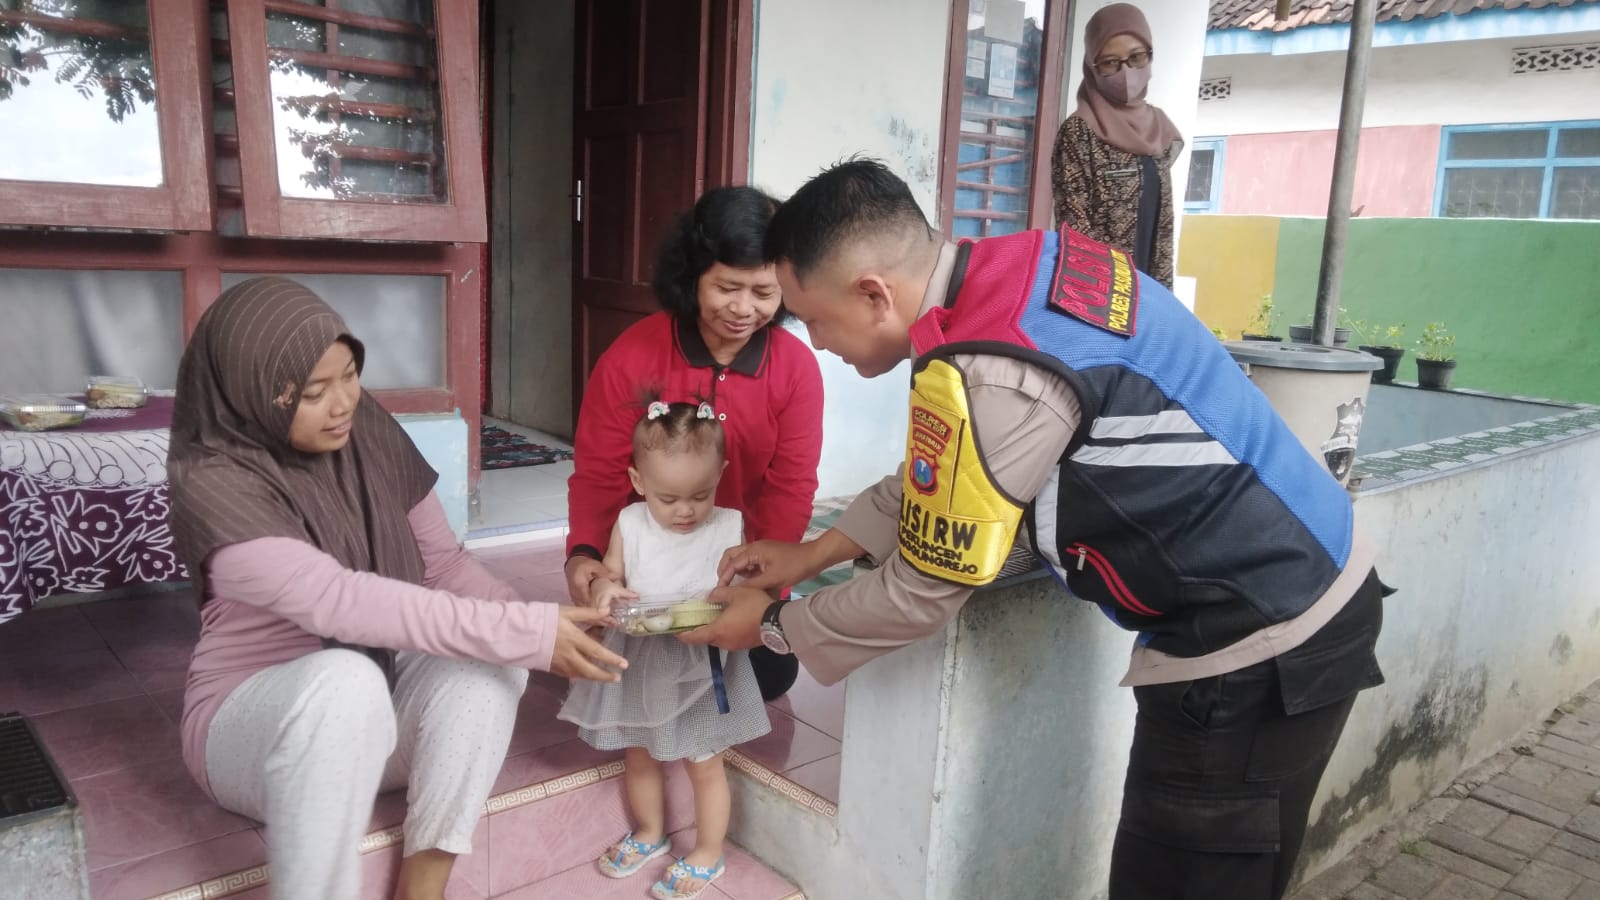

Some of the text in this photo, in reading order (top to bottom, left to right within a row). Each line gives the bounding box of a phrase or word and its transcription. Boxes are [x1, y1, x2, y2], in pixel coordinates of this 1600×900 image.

[1059, 248, 1111, 325] POLISI
[1108, 293, 1130, 331] POLRES
[934, 516, 977, 551] RW
